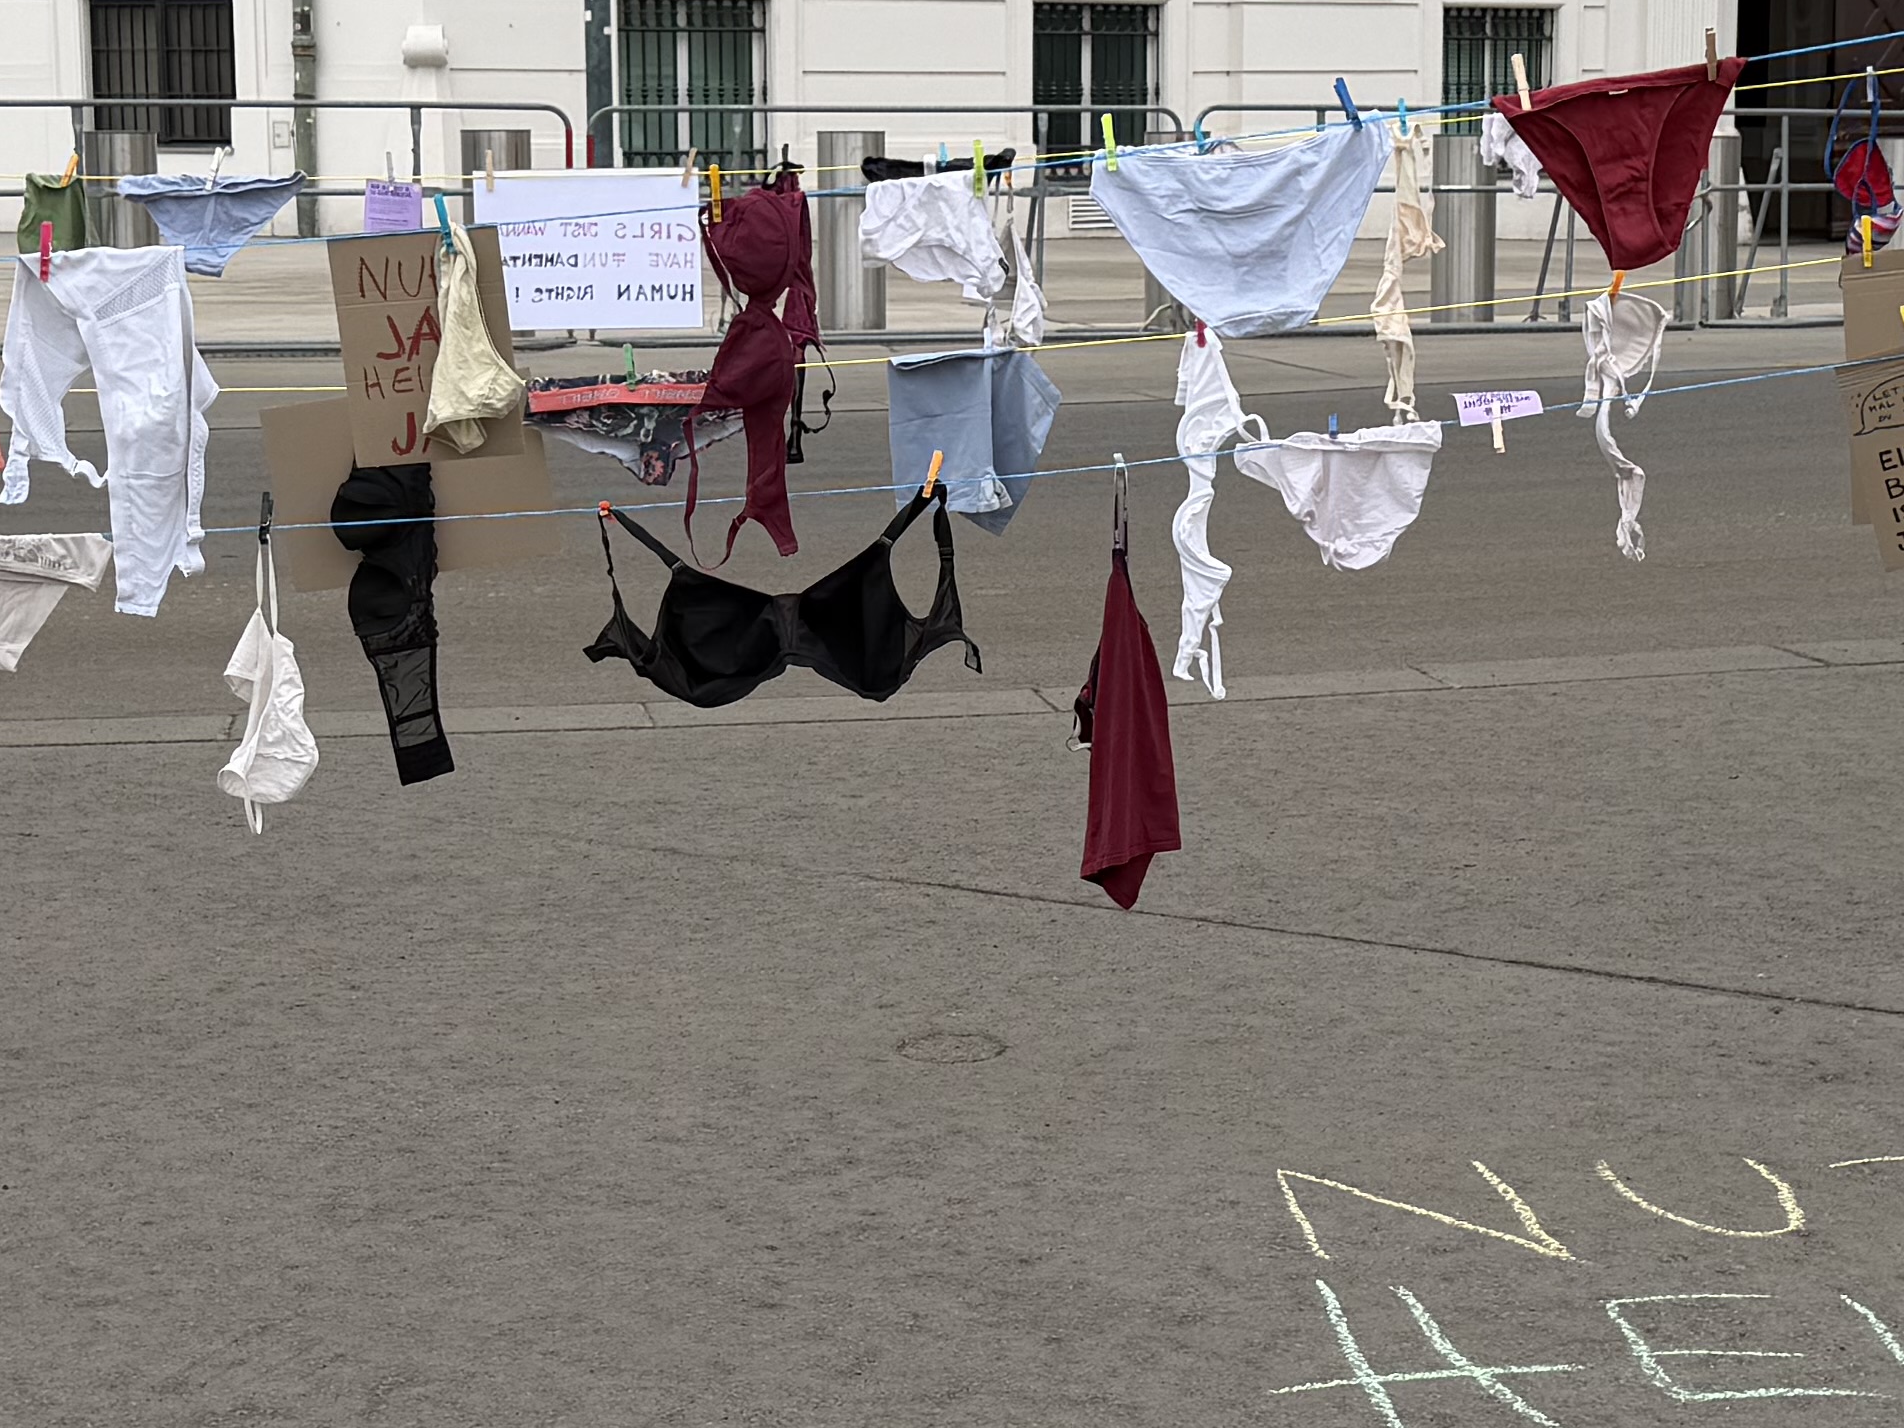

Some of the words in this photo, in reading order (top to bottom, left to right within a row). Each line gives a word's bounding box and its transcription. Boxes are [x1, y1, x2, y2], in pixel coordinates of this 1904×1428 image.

[375, 305, 443, 363] JA
[363, 363, 425, 401] HEI
[1868, 400, 1896, 414] MAL
[1877, 414, 1893, 423] DU
